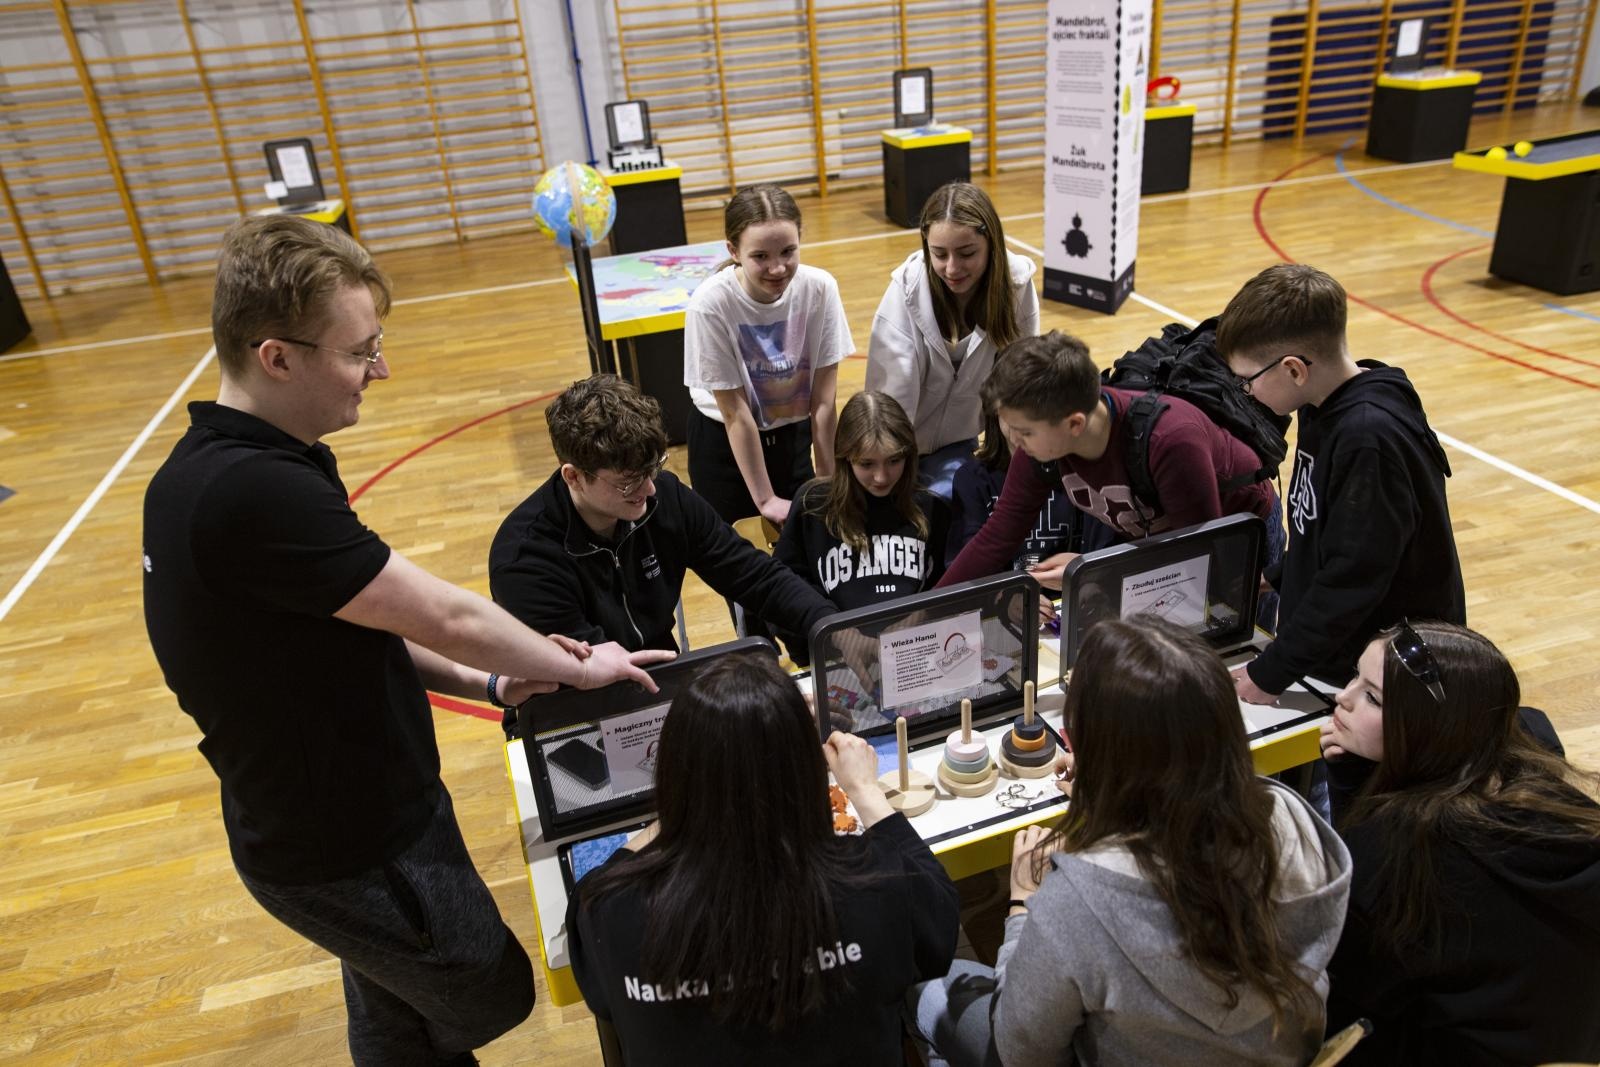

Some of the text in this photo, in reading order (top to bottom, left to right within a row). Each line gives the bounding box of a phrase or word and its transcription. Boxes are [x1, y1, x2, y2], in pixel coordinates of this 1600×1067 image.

[1055, 16, 1107, 27] Mandelbrot,
[1053, 30, 1077, 41] ojciec
[1052, 156, 1106, 171] Mandelbrota
[915, 632, 937, 642] Hanoi
[614, 719, 653, 734] Magiczny
